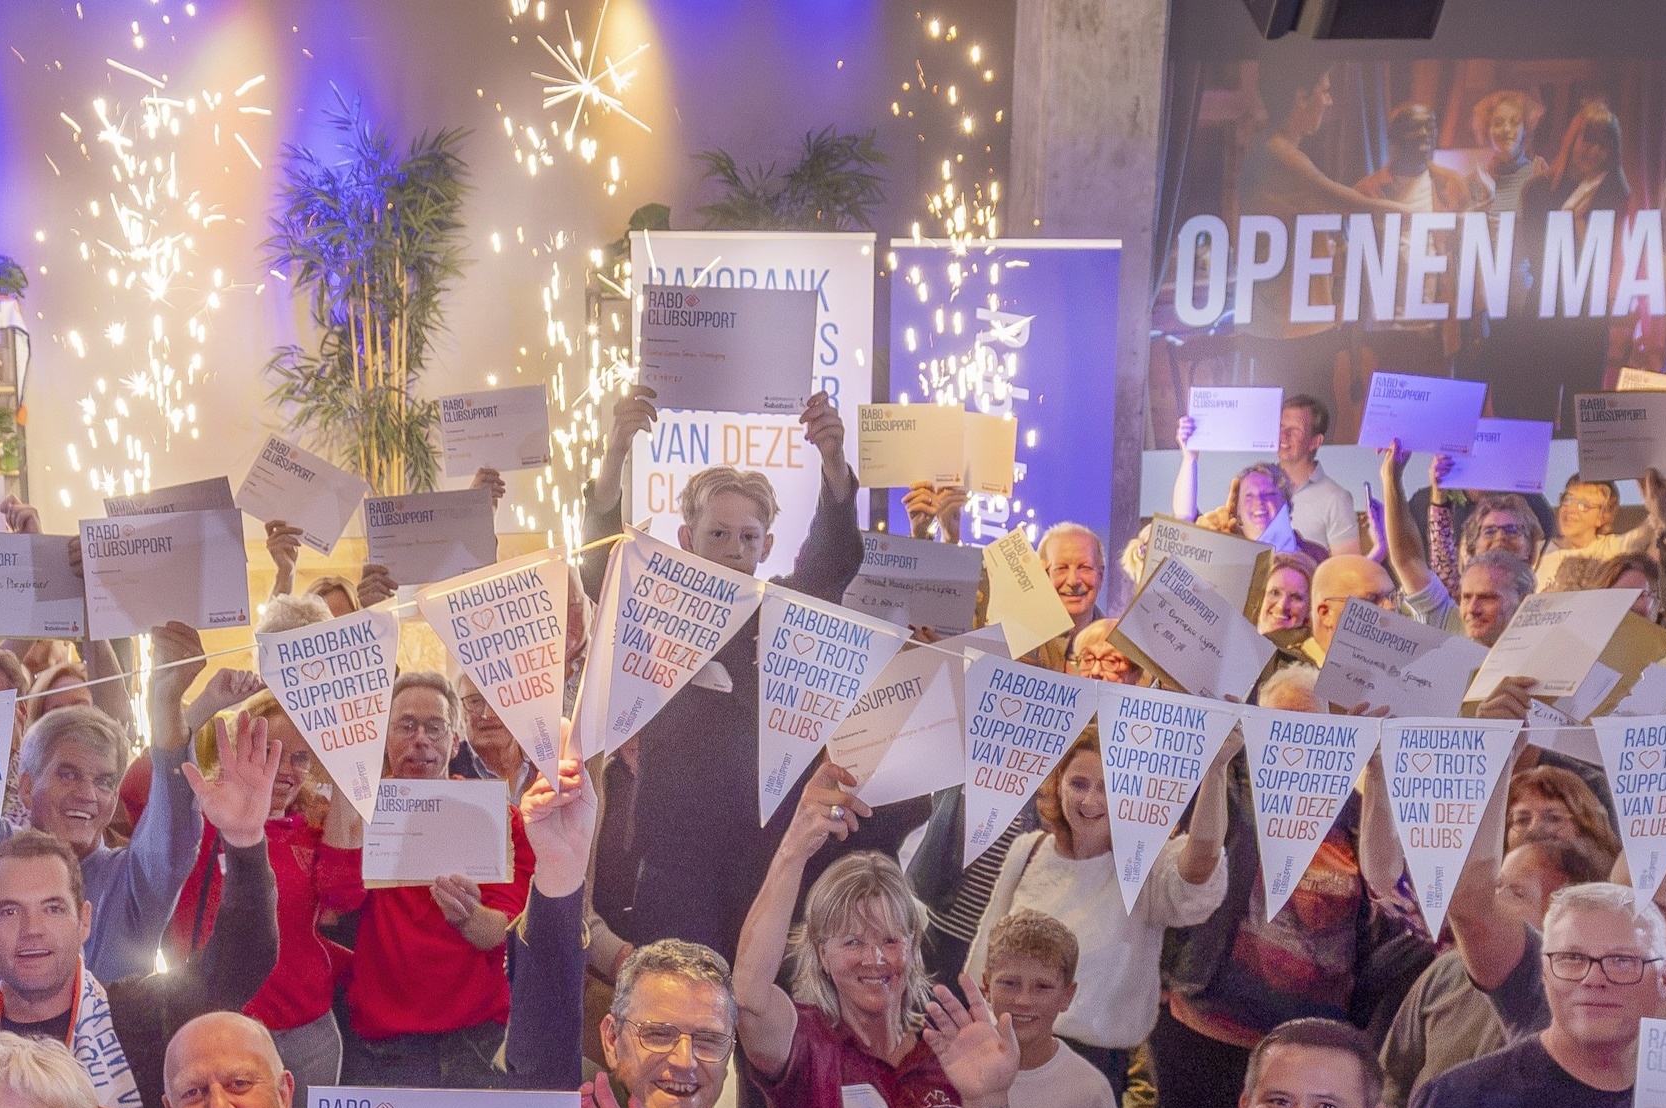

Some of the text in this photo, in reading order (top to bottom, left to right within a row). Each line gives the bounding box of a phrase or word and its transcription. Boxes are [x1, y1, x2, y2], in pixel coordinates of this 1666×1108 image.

[1174, 208, 1517, 327] OPENEN
[648, 309, 737, 328] CLUBSUPPORT
[649, 291, 683, 309] RABO
[267, 438, 291, 459] RABO
[650, 422, 804, 468] VAN DEZE
[261, 447, 315, 484] CLUBSUPPORT
[369, 499, 393, 515] RABO
[369, 509, 433, 529] CLUBSUPPORT
[86, 523, 120, 543] RABO
[87, 537, 173, 557] CLUBSUPPORT
[1010, 532, 1029, 556] RABO
[1154, 537, 1213, 564] CLUBSUPPORT
[1156, 525, 1180, 541] RABO
[644, 550, 742, 605] RABOBANK
[999, 538, 1034, 593] CLUBSUPPORT
[1167, 560, 1194, 585] RABO
[632, 575, 732, 630] IS TROTS
[1159, 571, 1220, 626] CLUBSUPPORT
[1349, 602, 1379, 624] RABO
[278, 619, 376, 665] RABOBANK
[622, 597, 721, 652] SUPPORTER
[1342, 617, 1420, 658] CLUBSUPPORT
[281, 645, 384, 687] IS TROTS
[622, 628, 703, 672] VAN DEZE
[621, 653, 678, 690] CLUBS
[988, 668, 1079, 708] RABOBANK
[286, 670, 390, 713] SUPPORTER
[300, 692, 387, 733] VAN DEZE
[978, 691, 1076, 733] IS TROTS
[321, 719, 379, 753] CLUBS
[969, 713, 1067, 757] SUPPORTER
[971, 742, 1049, 778] VAN DEZE
[1619, 748, 1635, 772] IS
[974, 769, 1030, 797] CLUBS
[1621, 796, 1654, 817] VAN
